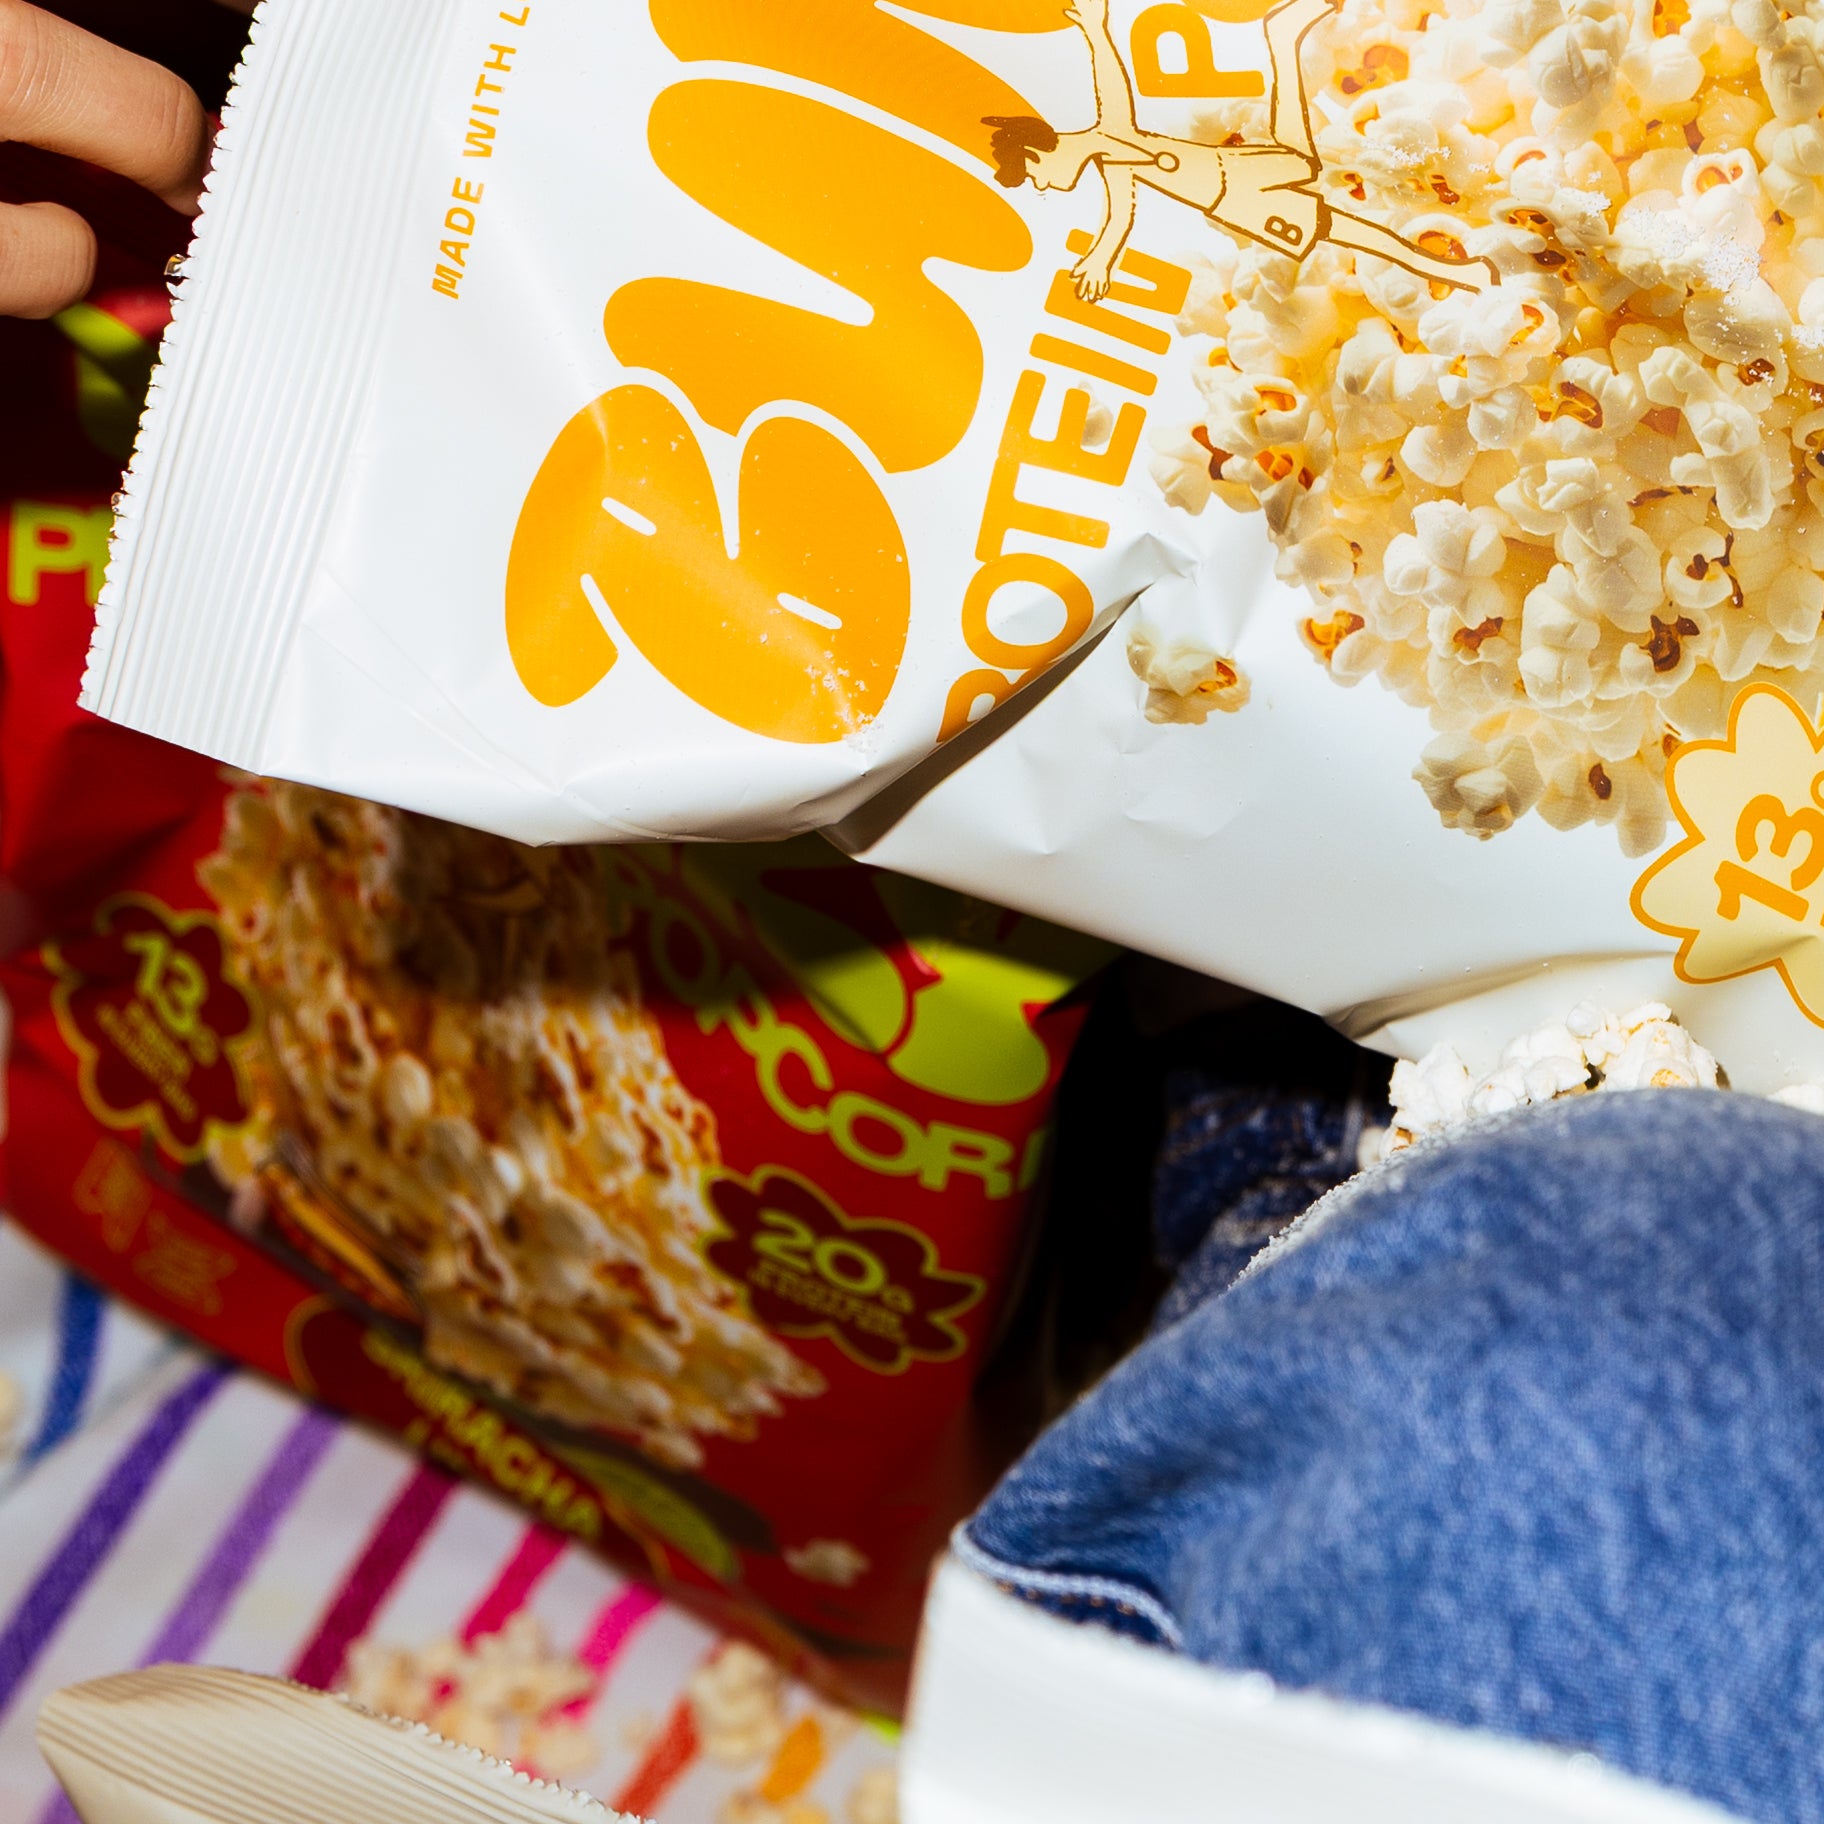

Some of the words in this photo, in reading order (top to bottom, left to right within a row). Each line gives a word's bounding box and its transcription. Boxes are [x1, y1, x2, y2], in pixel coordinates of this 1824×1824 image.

[431, 176, 485, 301] MADE
[462, 43, 517, 159] WITH
[935, 227, 1193, 744] ROTEIN
